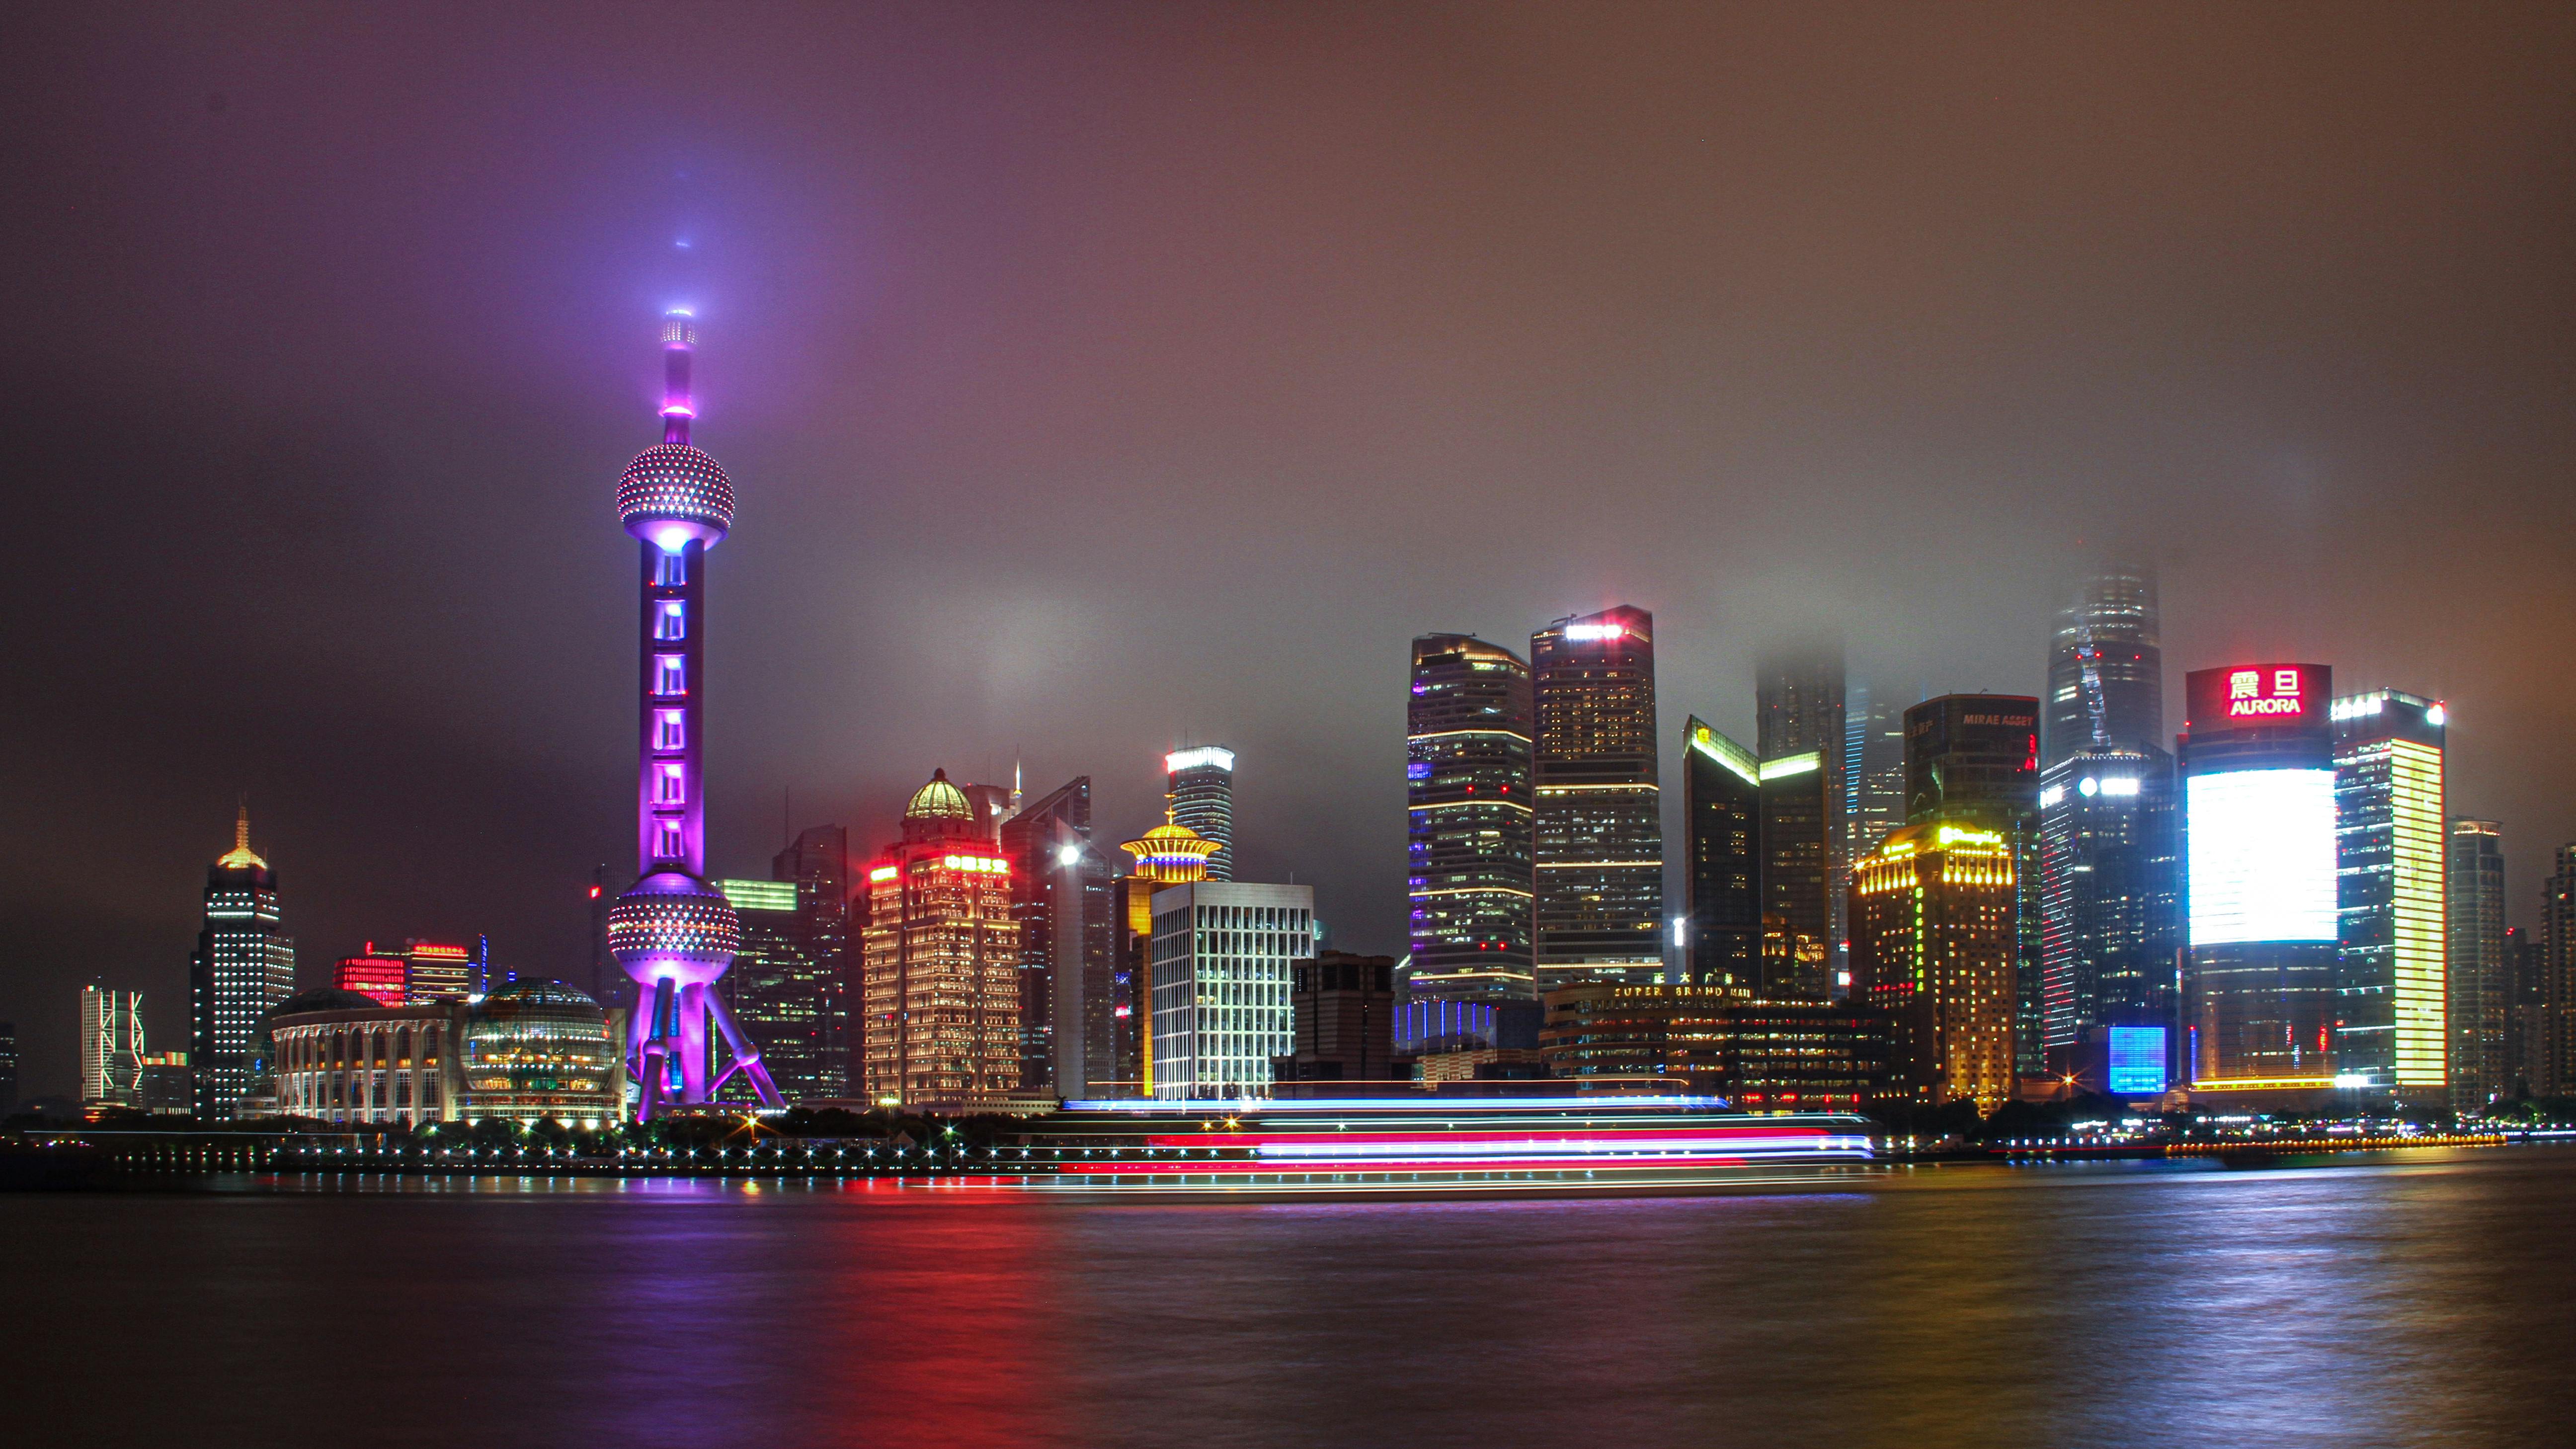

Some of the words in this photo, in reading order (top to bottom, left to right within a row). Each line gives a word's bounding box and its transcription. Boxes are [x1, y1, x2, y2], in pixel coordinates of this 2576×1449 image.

[2230, 671, 2300, 699] 震旦
[2230, 699, 2301, 716] AURORA
[1963, 715, 2000, 725] MIRAE
[2001, 716, 2033, 726] ASSET
[1614, 986, 1663, 997] SUPER
[1676, 986, 1722, 996] BRAND
